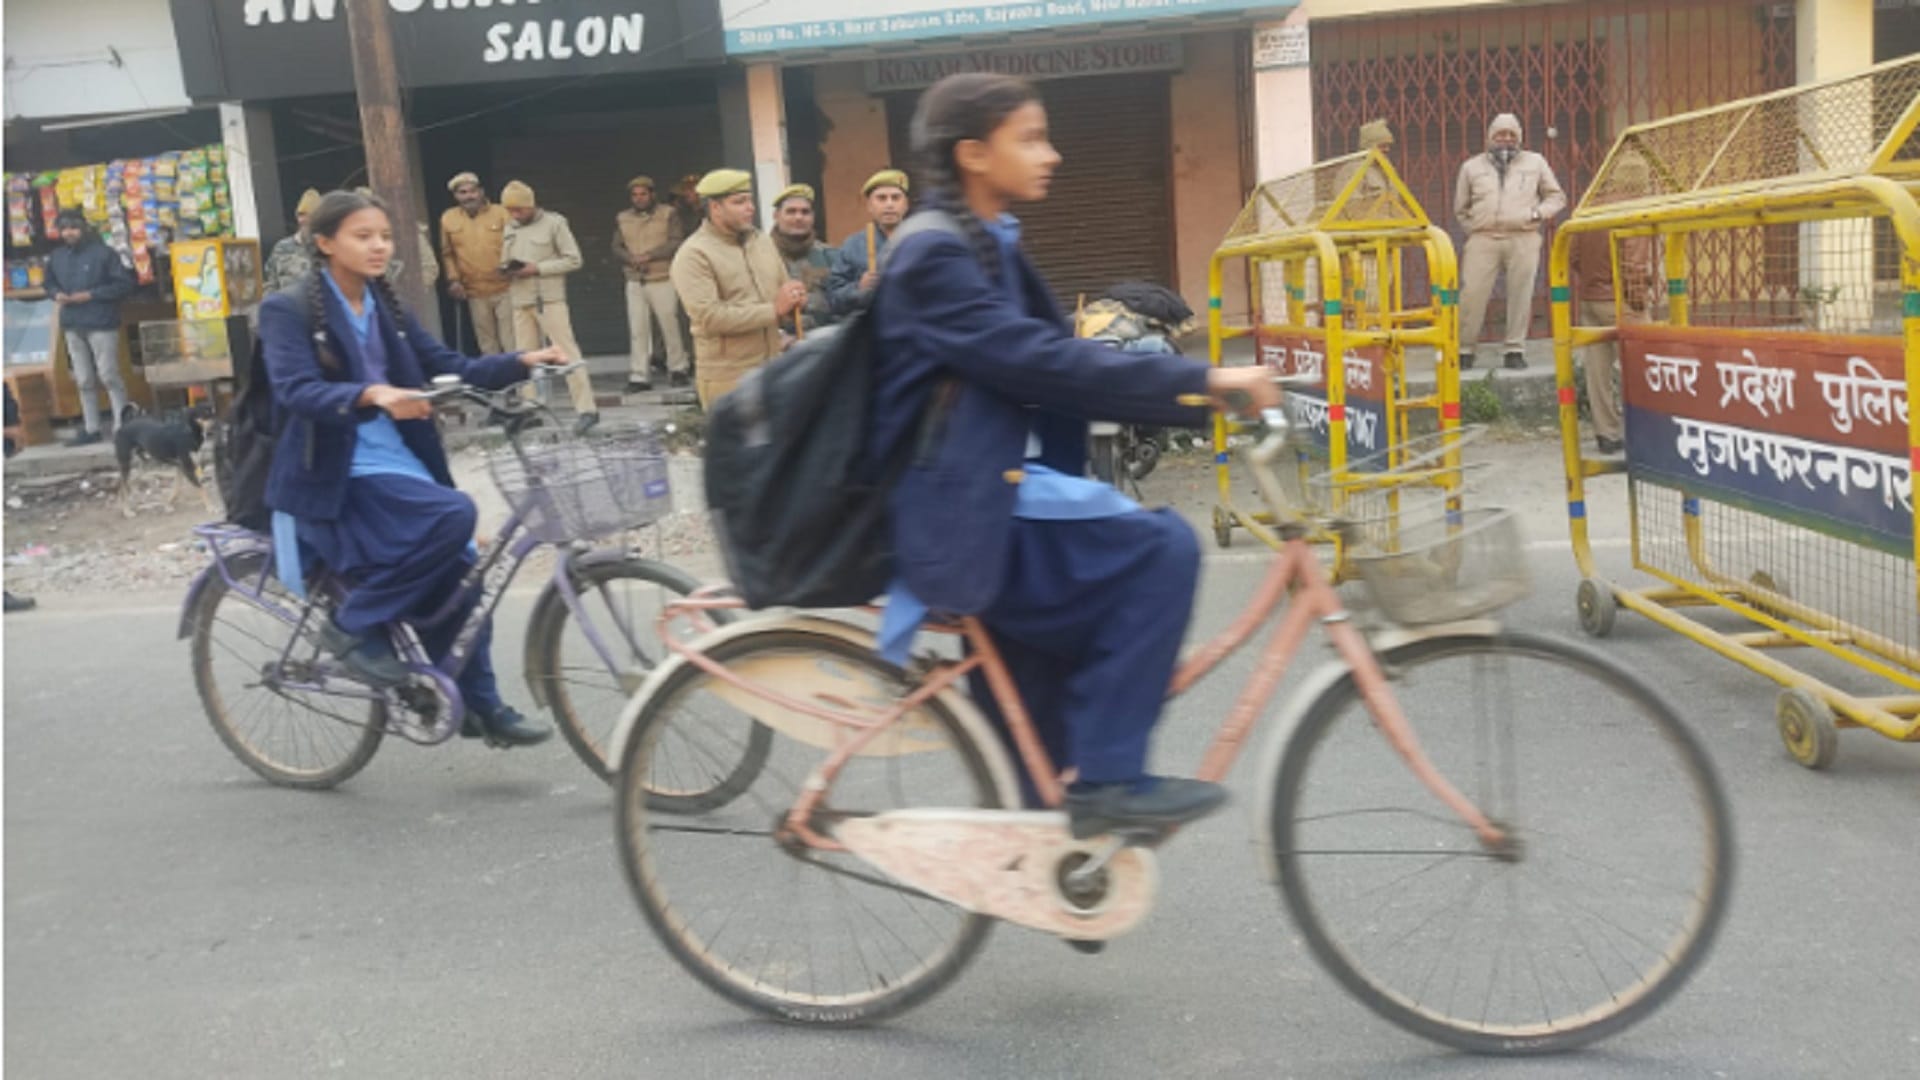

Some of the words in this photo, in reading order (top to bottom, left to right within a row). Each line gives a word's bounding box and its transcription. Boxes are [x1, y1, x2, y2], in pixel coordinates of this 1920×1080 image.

[483, 13, 646, 63] SALON
[738, 29, 774, 45] Shop
[877, 55, 961, 85] KUMAR
[967, 47, 1090, 76] MEDICINE
[1089, 42, 1176, 68] STORE
[1645, 353, 1701, 397] उत्तर
[1715, 348, 1796, 418] प्रदेश
